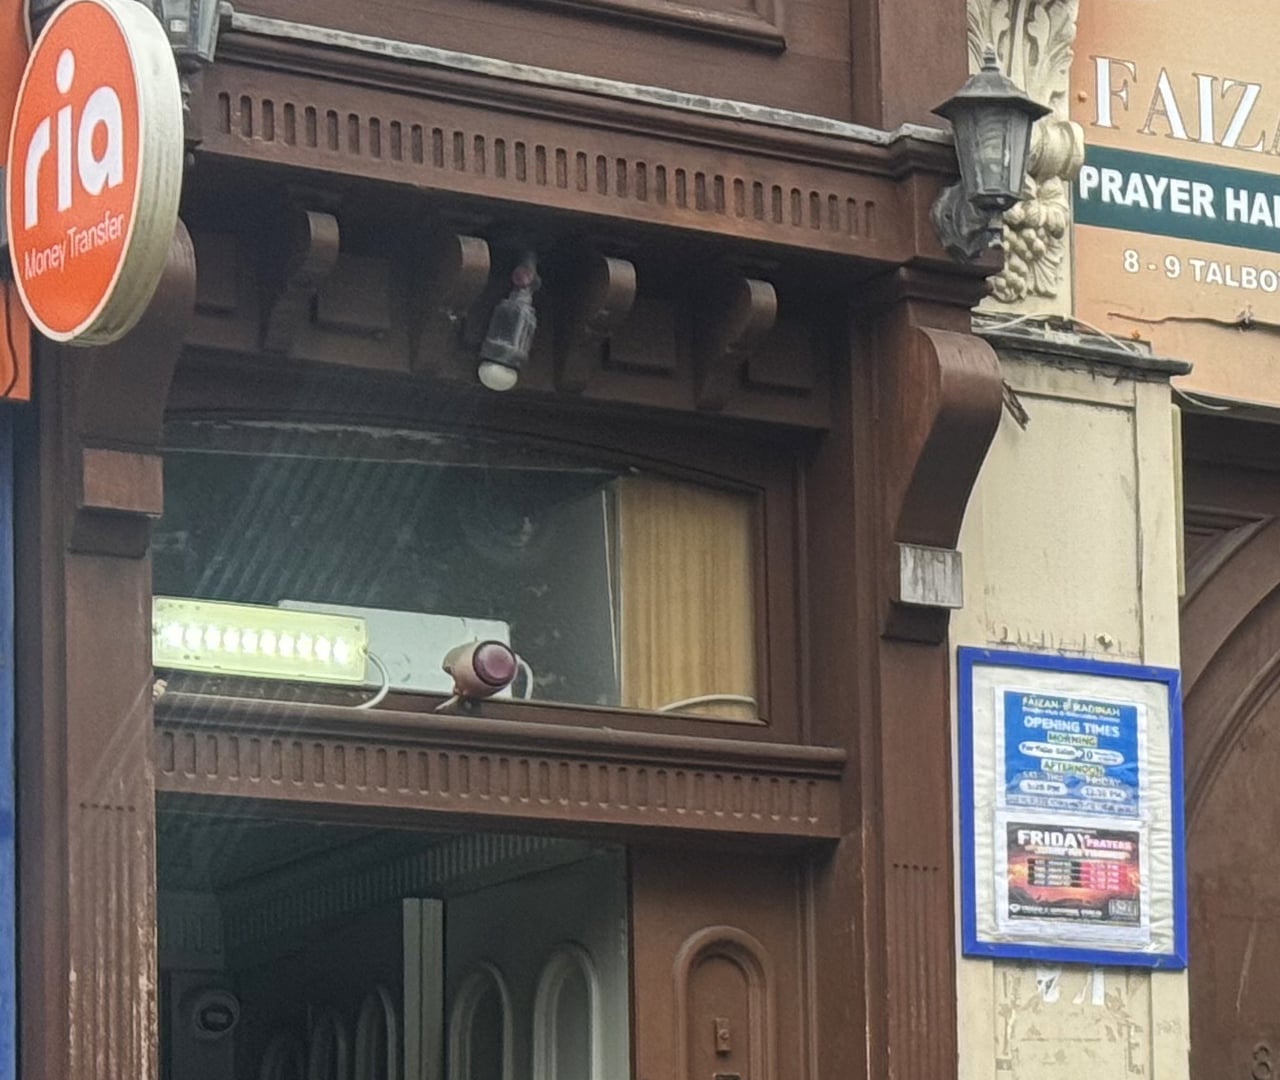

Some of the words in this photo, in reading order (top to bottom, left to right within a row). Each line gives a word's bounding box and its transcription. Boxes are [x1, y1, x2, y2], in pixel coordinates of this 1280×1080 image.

[24, 48, 124, 230] ria
[1080, 165, 1216, 218] PRAYER
[25, 242, 66, 280] Money
[67, 210, 125, 260] Transfer
[1123, 250, 1140, 273] 8
[1164, 255, 1181, 278] 9
[1024, 716, 1080, 733] OPENING
[1083, 722, 1120, 737] TIMES
[1049, 733, 1097, 746] MORNING
[1043, 760, 1104, 777] AFTERNOON
[1017, 830, 1088, 850] FRIDAY
